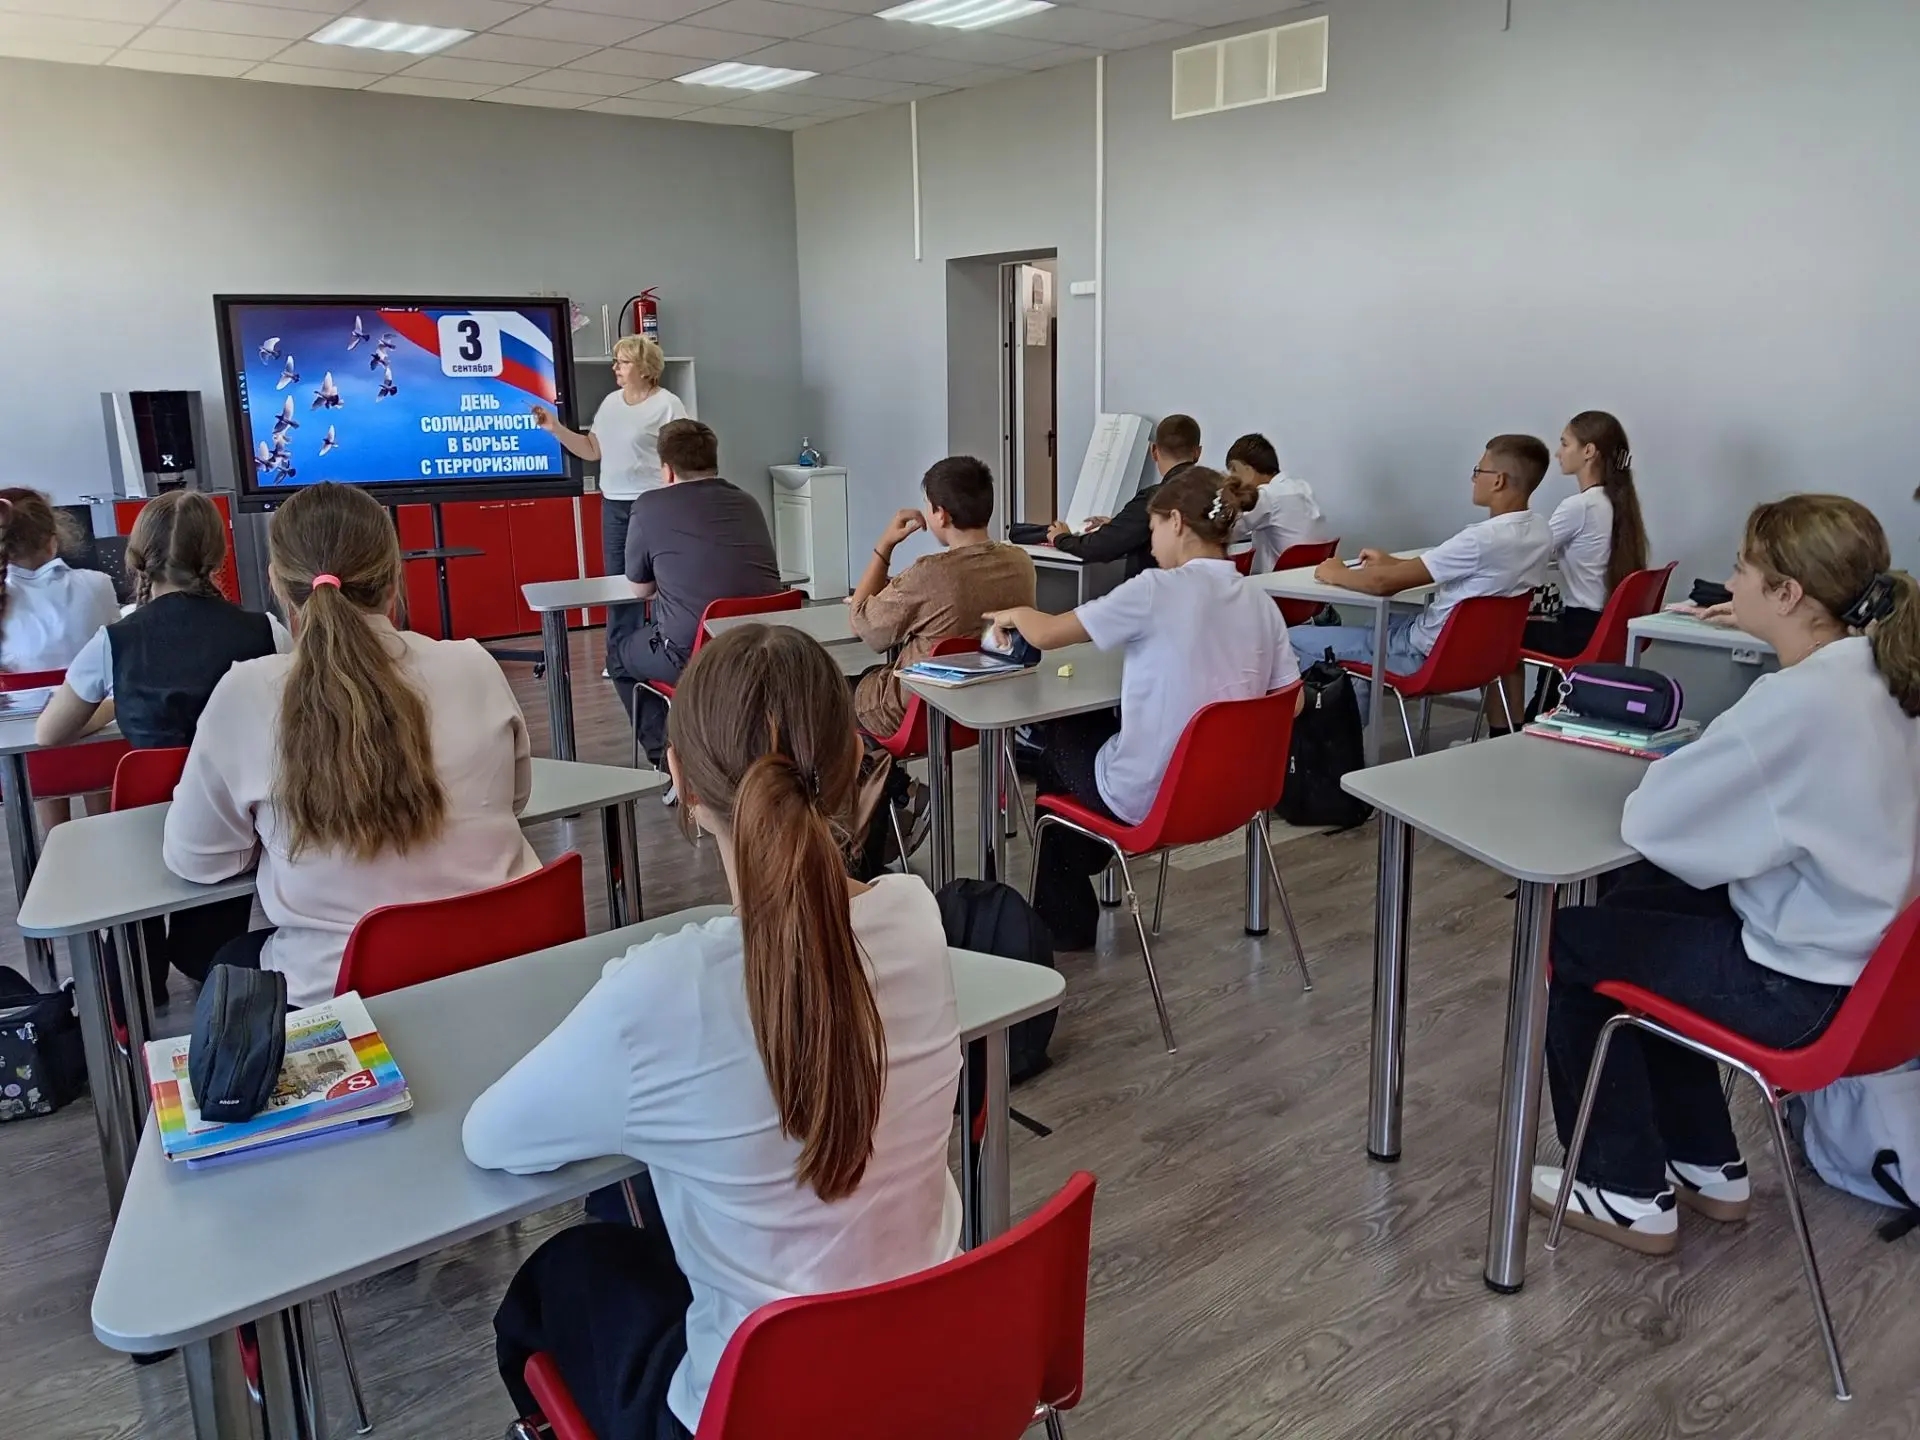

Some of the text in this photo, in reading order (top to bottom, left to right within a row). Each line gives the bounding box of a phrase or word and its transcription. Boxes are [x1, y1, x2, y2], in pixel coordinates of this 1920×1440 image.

[457, 319, 483, 361] 3
[452, 364, 493, 374] сентября
[460, 394, 500, 412] ДЕНЬ
[447, 435, 520, 453] В БОРЬБЕ
[421, 455, 549, 475] С ТЕРРОРИЗМОМ
[347, 1075, 371, 1091] 8
